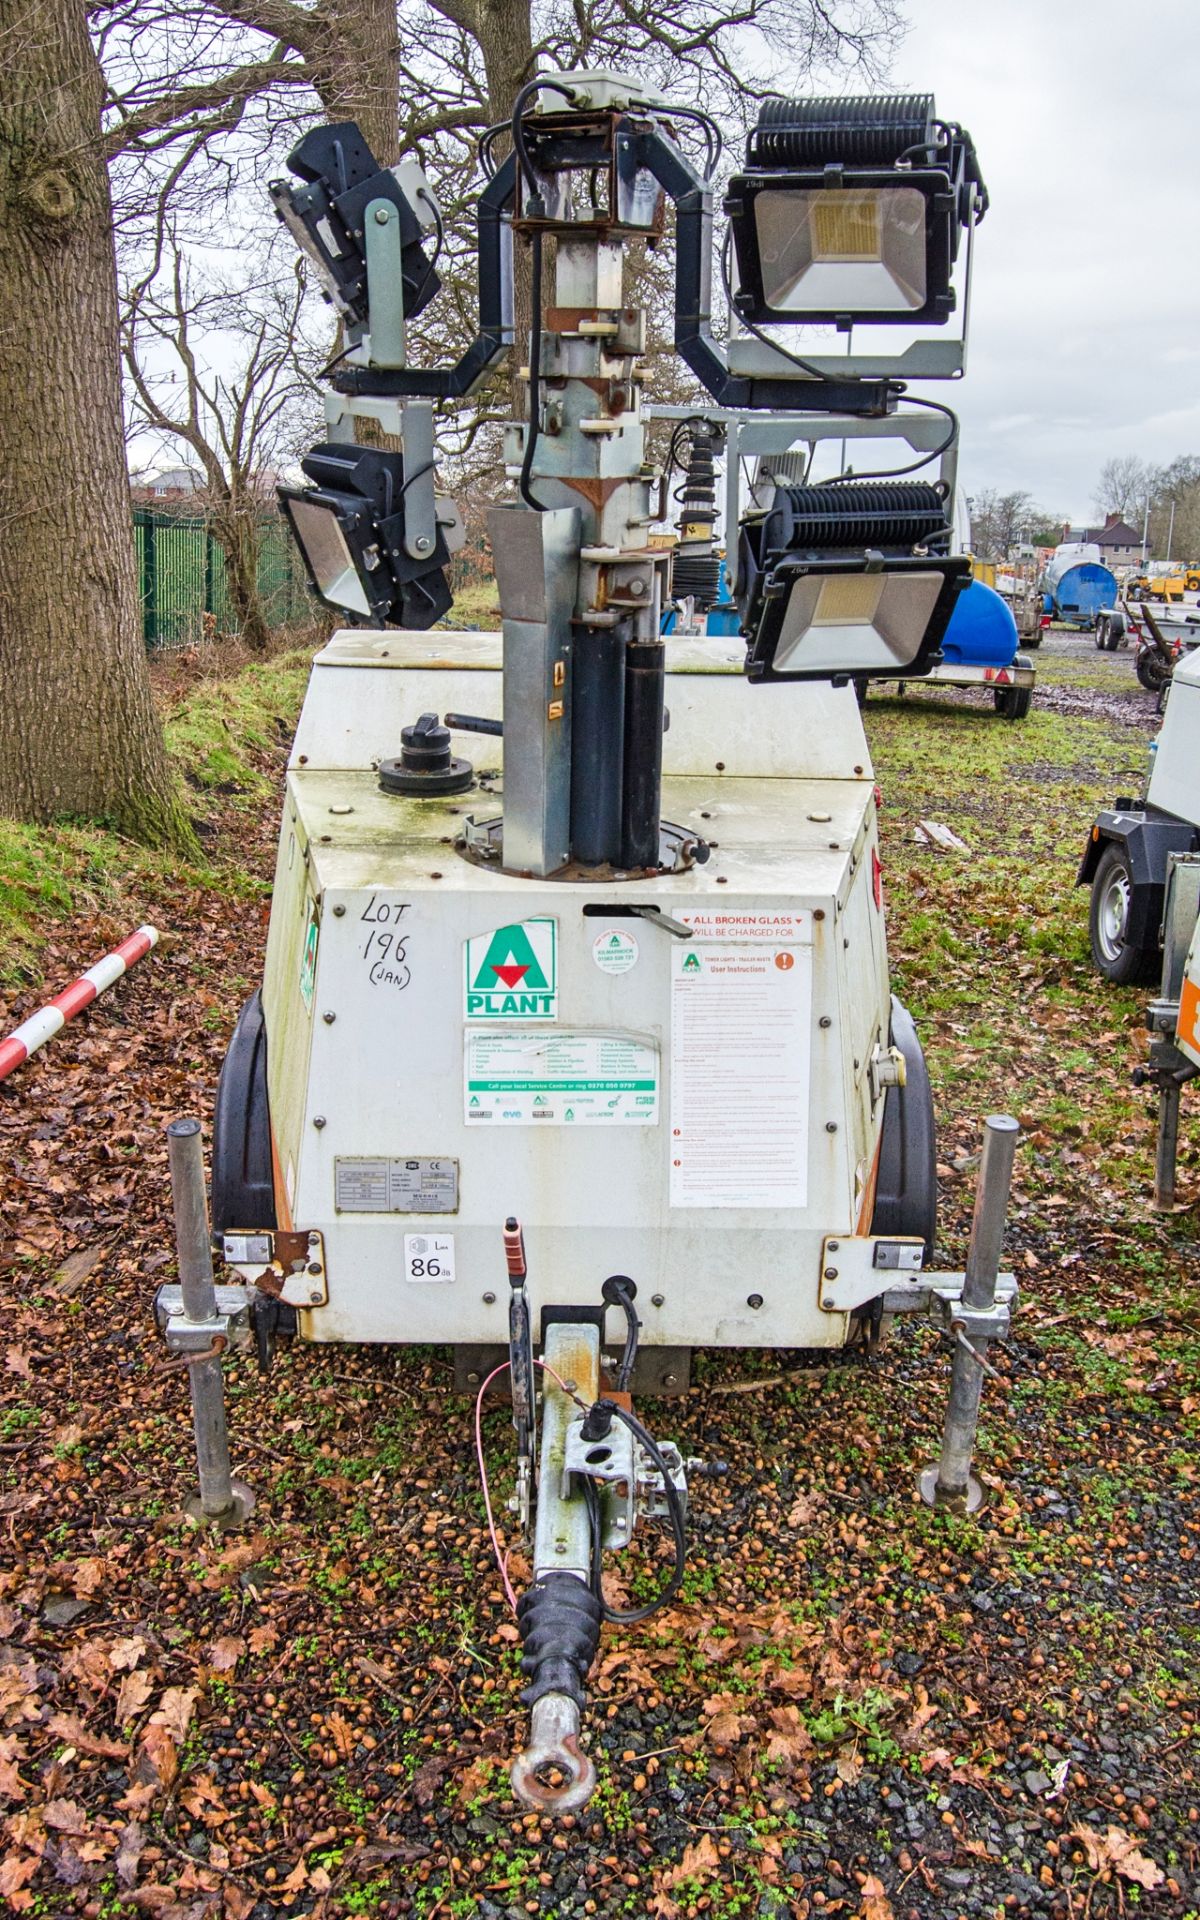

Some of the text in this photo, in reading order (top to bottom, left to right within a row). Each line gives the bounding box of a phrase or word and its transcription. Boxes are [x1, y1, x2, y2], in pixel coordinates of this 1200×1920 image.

[360, 893, 412, 925] LOT
[693, 916, 792, 924] ALL BROKEN GLASS
[691, 928, 794, 937] WILL BE CHARGED FOR
[363, 930, 410, 963] 196
[472, 924, 549, 989] A
[369, 961, 411, 990] (JAN)
[467, 995, 555, 1013] PLANT
[500, 1083, 512, 1091] your
[503, 1111, 522, 1119] eve
[411, 1258, 440, 1277] 86
